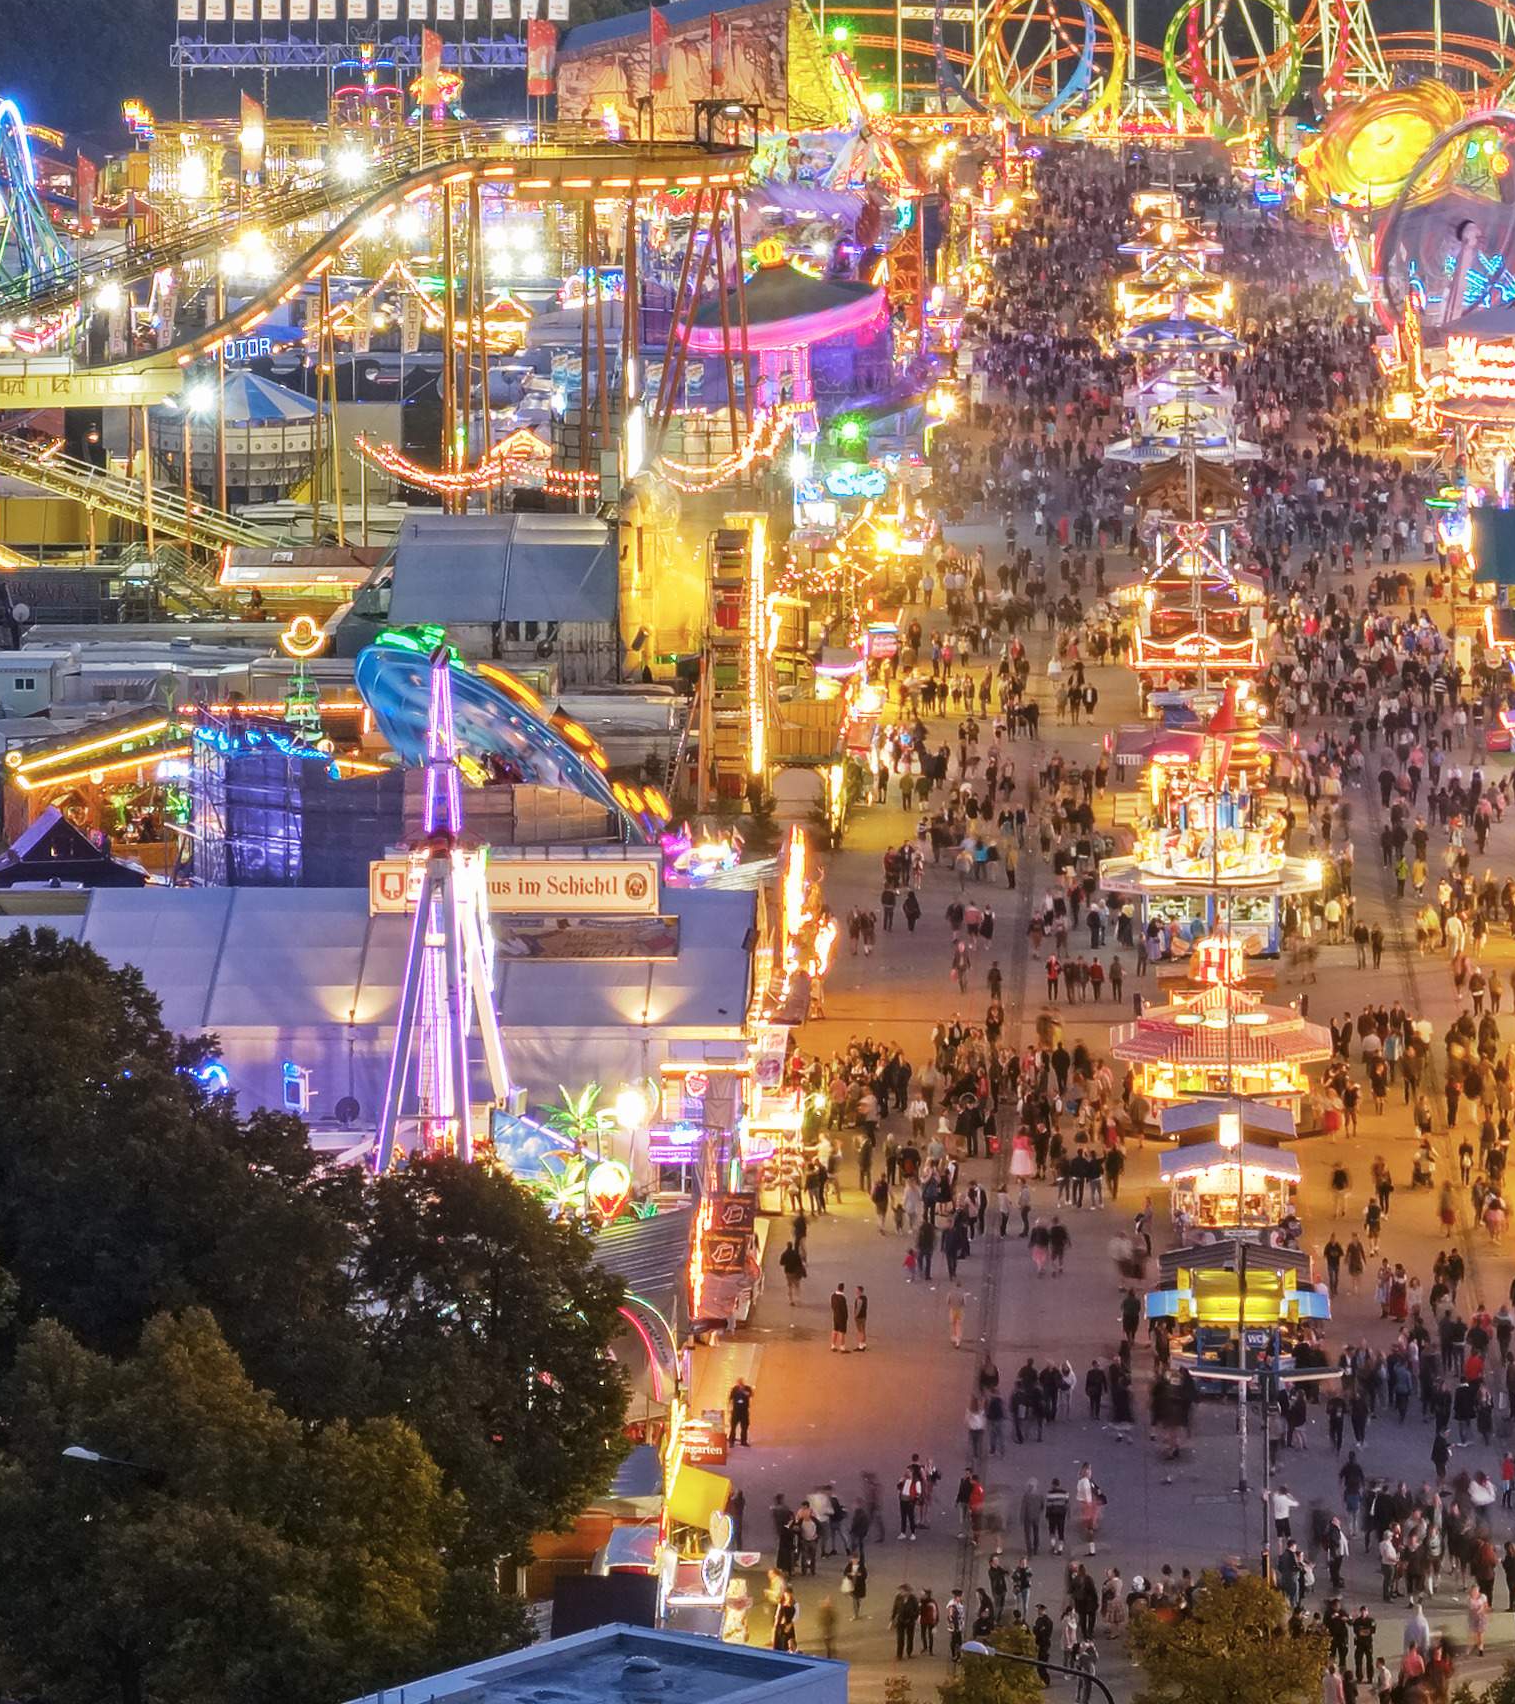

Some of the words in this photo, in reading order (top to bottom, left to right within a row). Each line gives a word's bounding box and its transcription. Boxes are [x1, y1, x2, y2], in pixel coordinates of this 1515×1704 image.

[518, 876, 541, 899] im
[546, 875, 618, 898] Schichtl
[1247, 1334, 1262, 1344] WC
